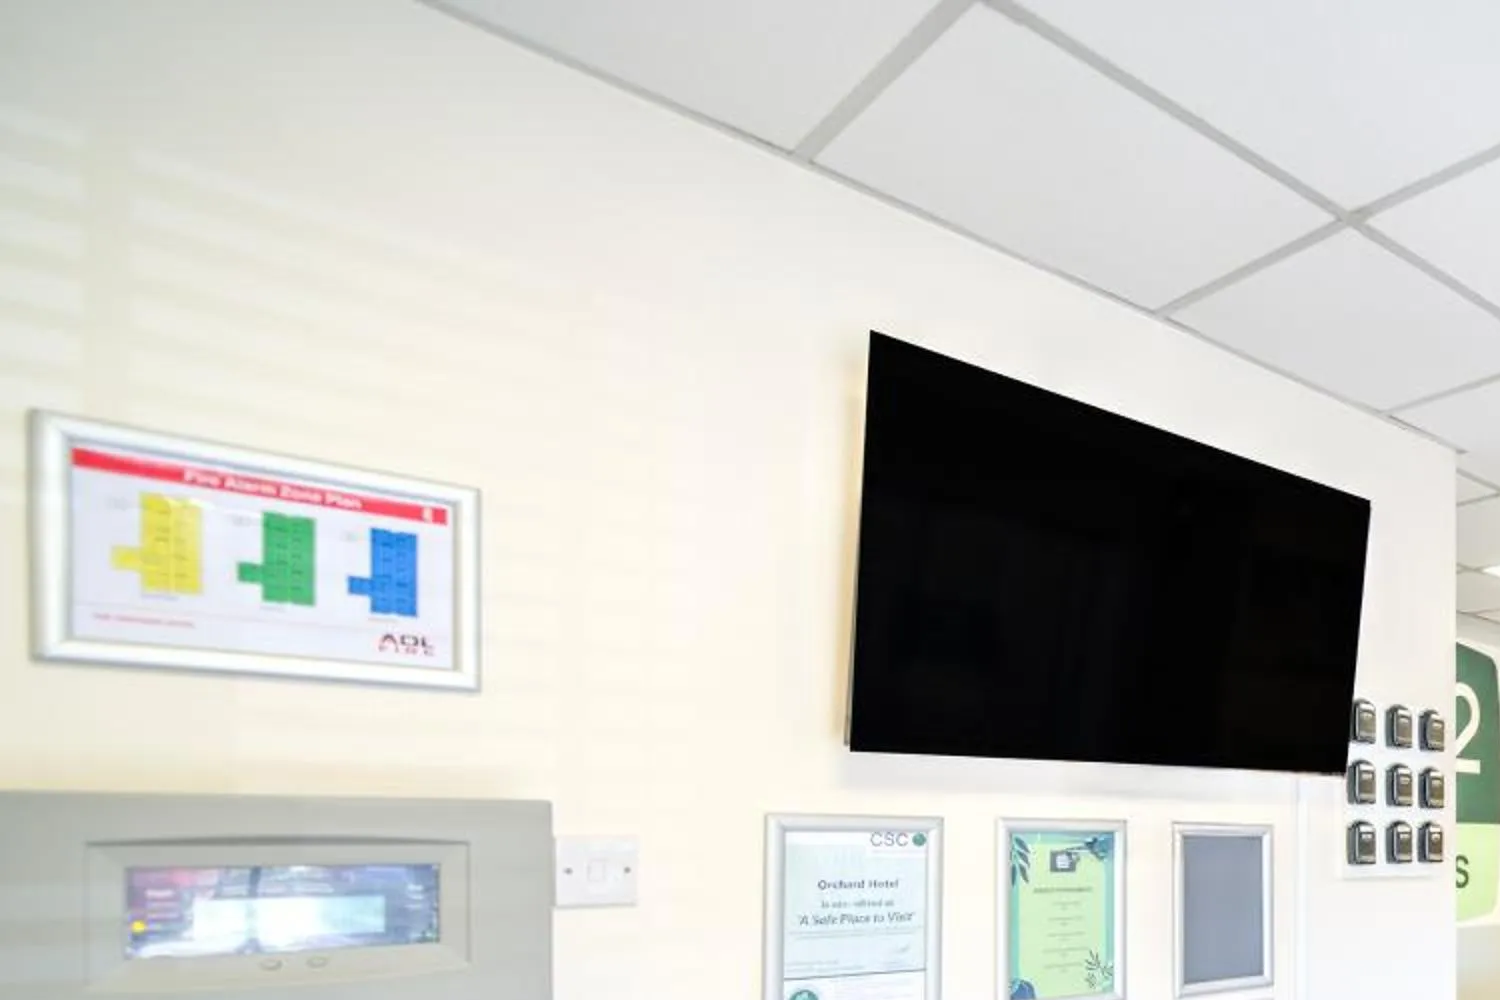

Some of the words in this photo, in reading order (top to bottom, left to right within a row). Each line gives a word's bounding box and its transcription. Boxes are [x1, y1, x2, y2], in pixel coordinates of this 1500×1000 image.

[869, 831, 909, 847] CSC
[817, 879, 865, 890] Orchard
[868, 878, 899, 889] Hotel
